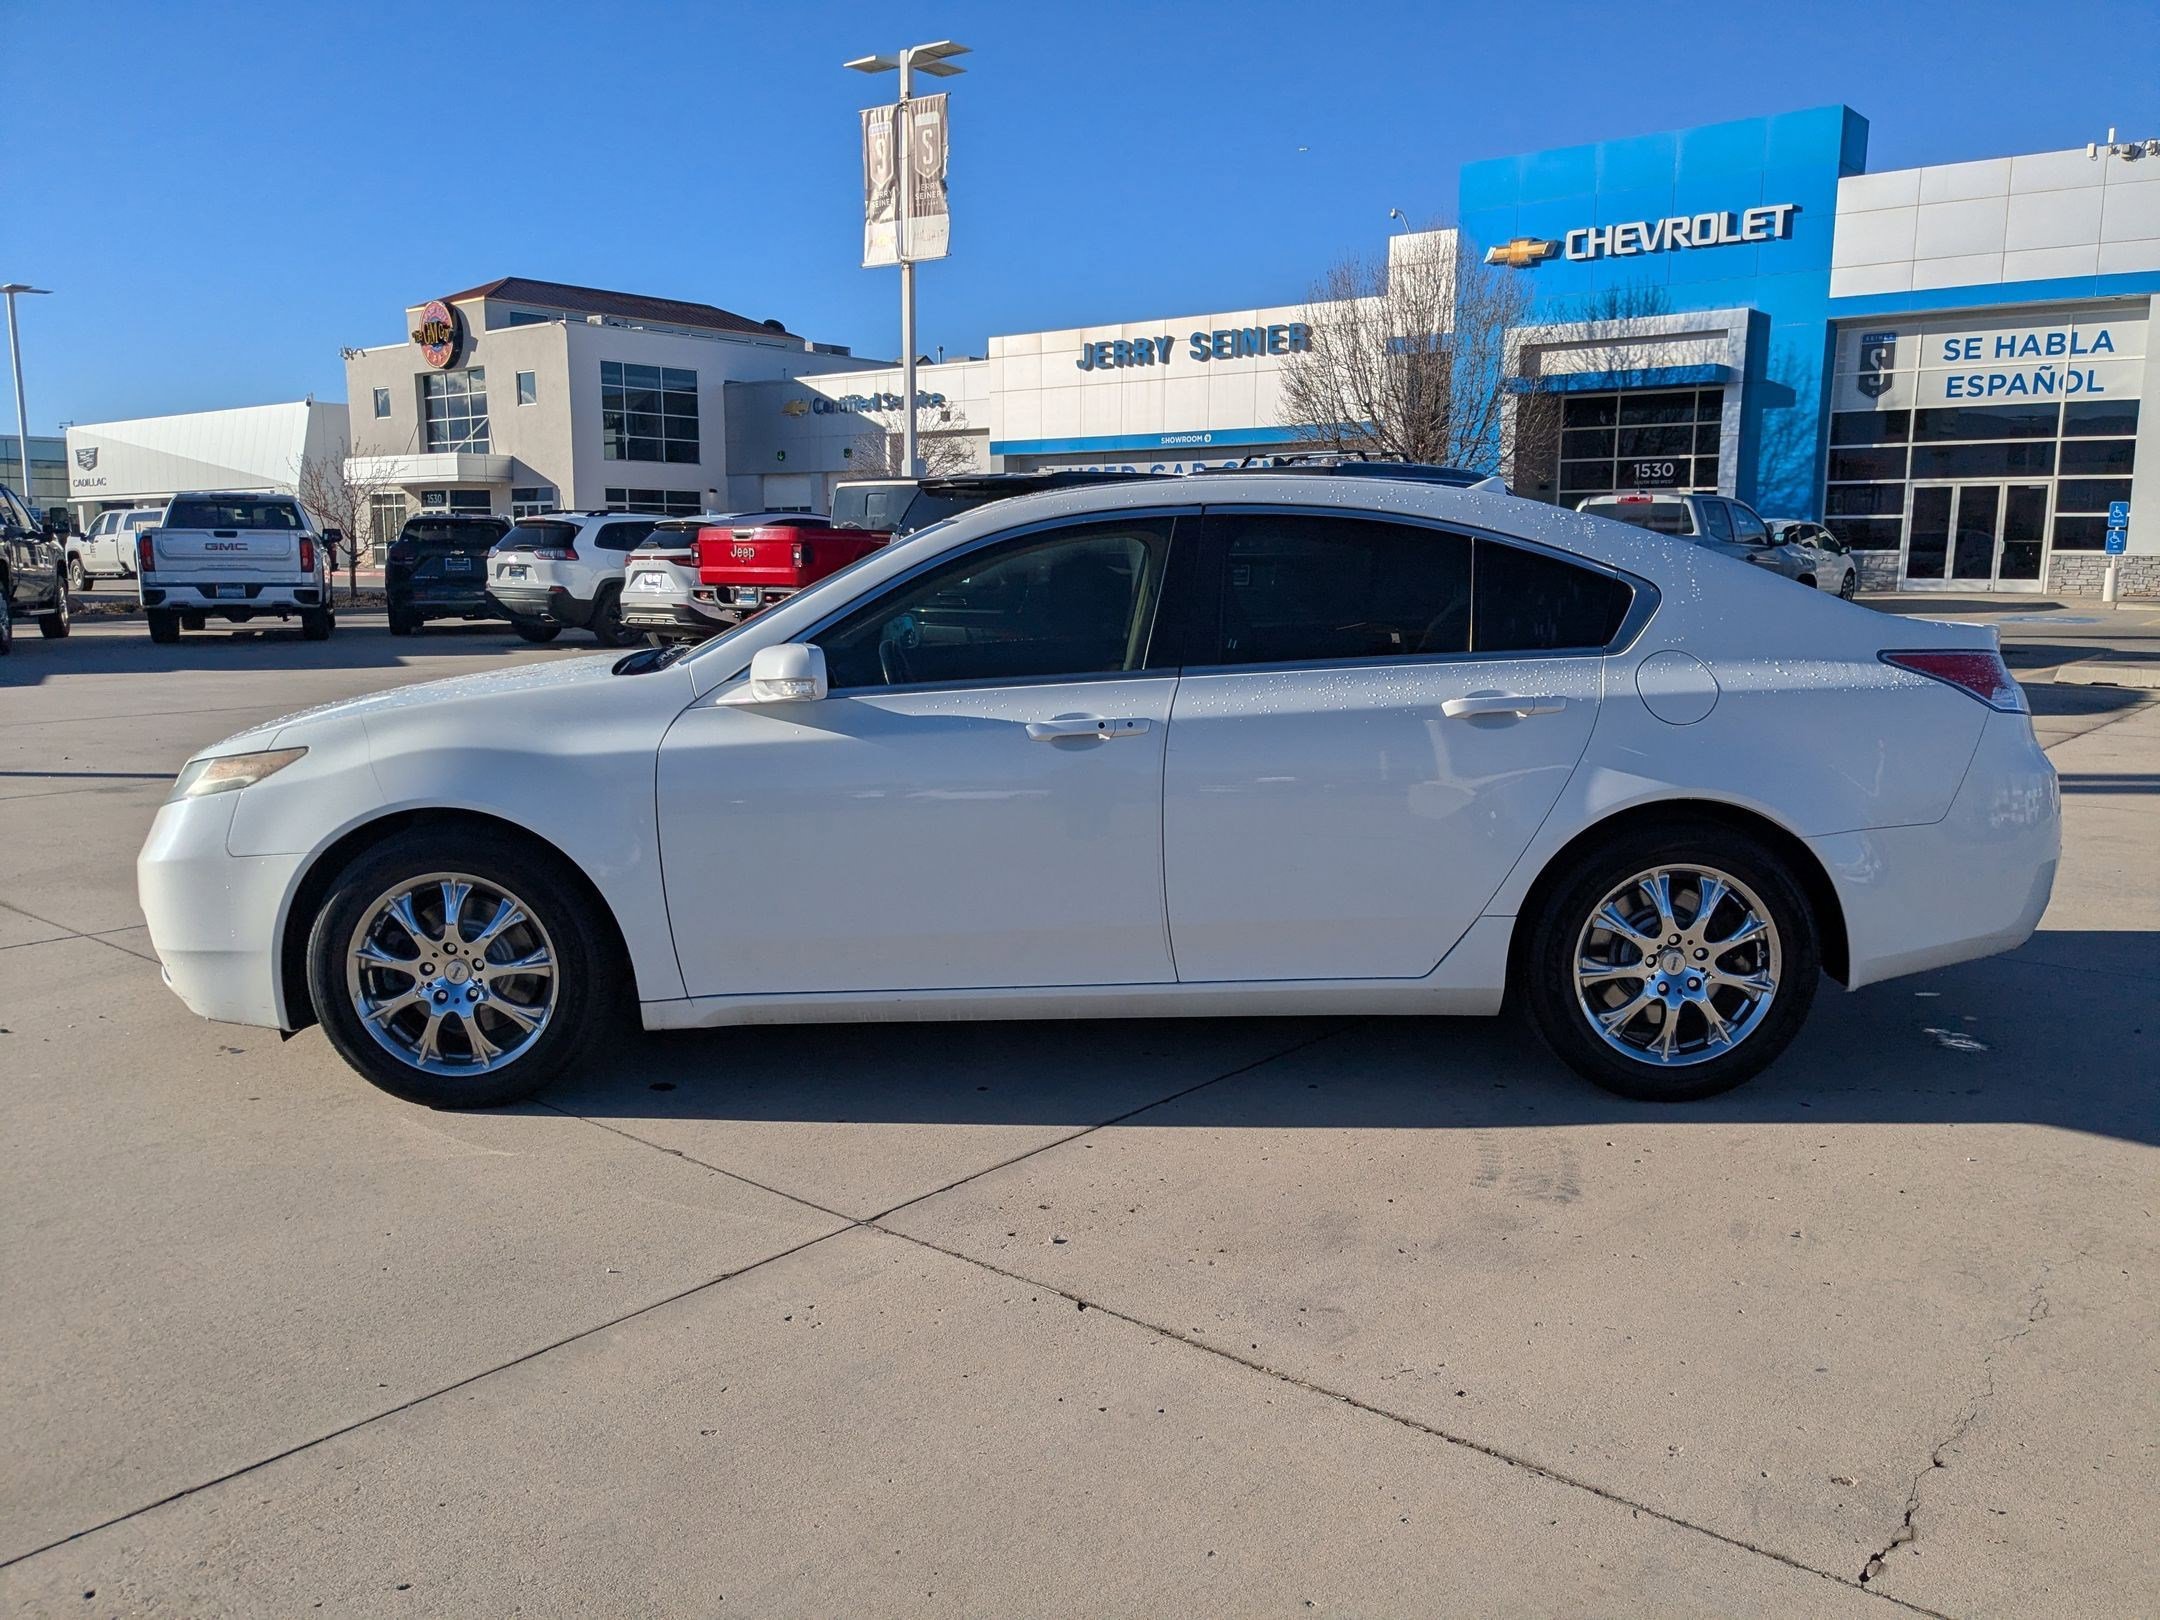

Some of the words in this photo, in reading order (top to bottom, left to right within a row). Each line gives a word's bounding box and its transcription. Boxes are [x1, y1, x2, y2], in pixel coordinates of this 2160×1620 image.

[918, 182, 940, 191] ERRY
[1565, 203, 1794, 260] CHEVROLET
[1076, 335, 1175, 371] JERRY
[1189, 322, 1313, 362] SEINER
[1943, 336, 1983, 362] SE
[1994, 329, 2115, 359] HABLA
[1945, 365, 2105, 399] ESPAÑOL
[1160, 435, 1203, 444] SHOWROOM
[1633, 462, 1674, 478] 1530
[72, 477, 107, 488] CADILLAC
[426, 494, 443, 504] 1530
[205, 542, 249, 551] GMC
[730, 545, 755, 559] Jeep
